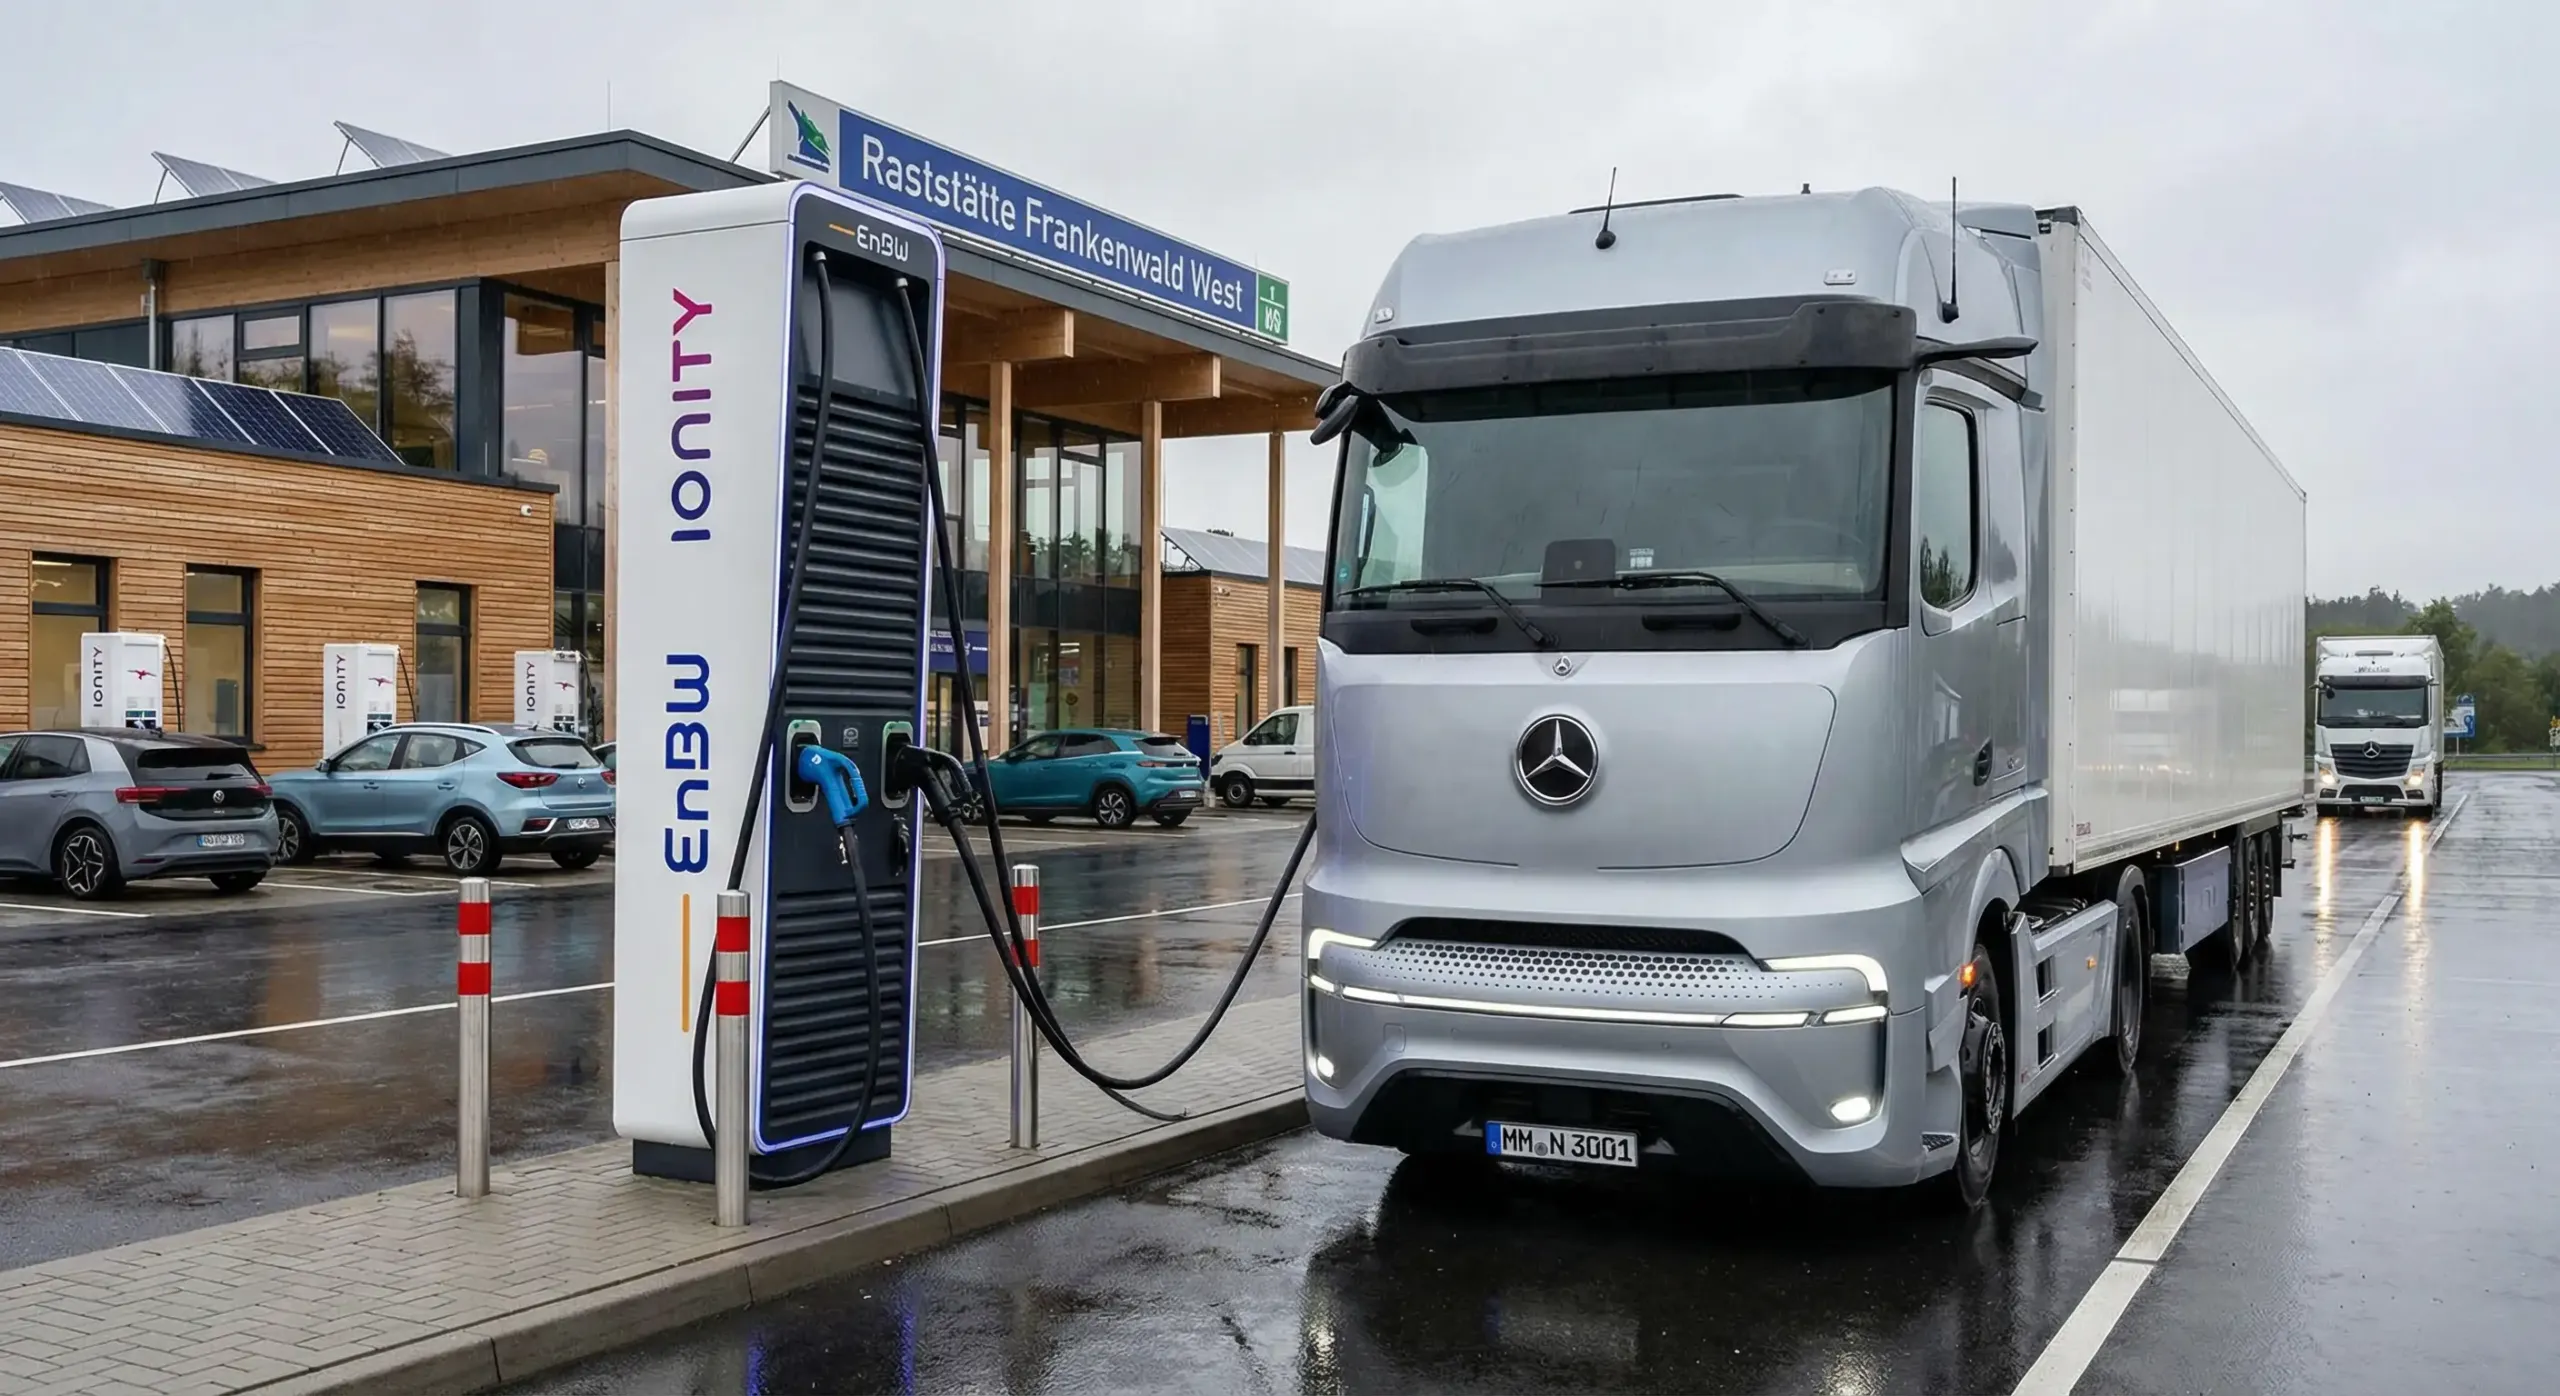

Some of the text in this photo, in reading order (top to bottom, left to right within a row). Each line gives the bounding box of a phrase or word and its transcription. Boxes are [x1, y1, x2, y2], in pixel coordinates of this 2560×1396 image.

[857, 224, 909, 262] EnBW
[862, 133, 1243, 313] Raststätte Frankenwald West
[671, 287, 713, 542] IONITY
[93, 646, 103, 707] IONITY
[336, 654, 346, 709] IONITY
[664, 653, 711, 874] EnBW
[1502, 1127, 1633, 1163] MM N 3001
